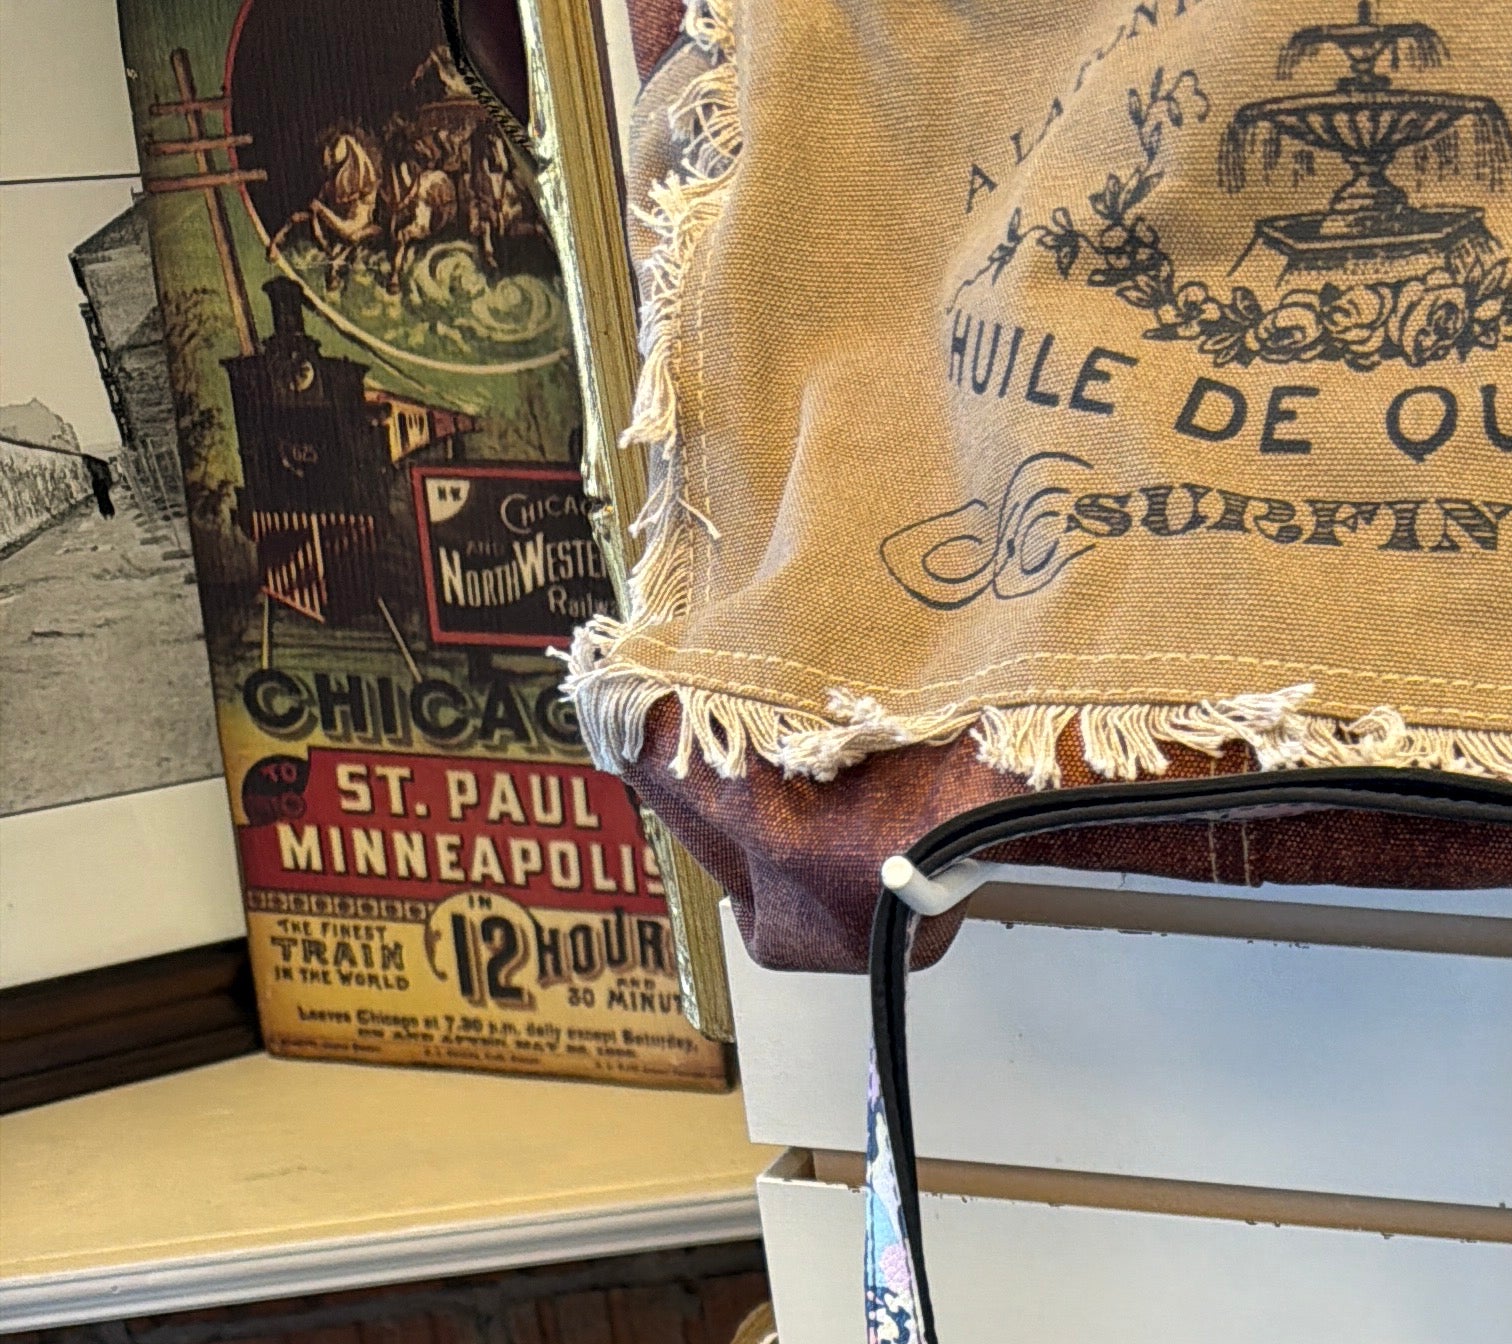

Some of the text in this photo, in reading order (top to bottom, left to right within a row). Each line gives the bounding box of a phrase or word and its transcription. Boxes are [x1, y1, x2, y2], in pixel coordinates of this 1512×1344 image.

[947, 307, 1139, 415] HUILE
[1173, 376, 1320, 455] DE
[336, 763, 428, 819] ST.
[446, 770, 600, 828] PAUL
[468, 894, 492, 909] IN
[277, 919, 312, 936] THE
[270, 936, 405, 971] TRAIN
[451, 912, 530, 1006] 12
[274, 966, 410, 991] IN THE WORLD
